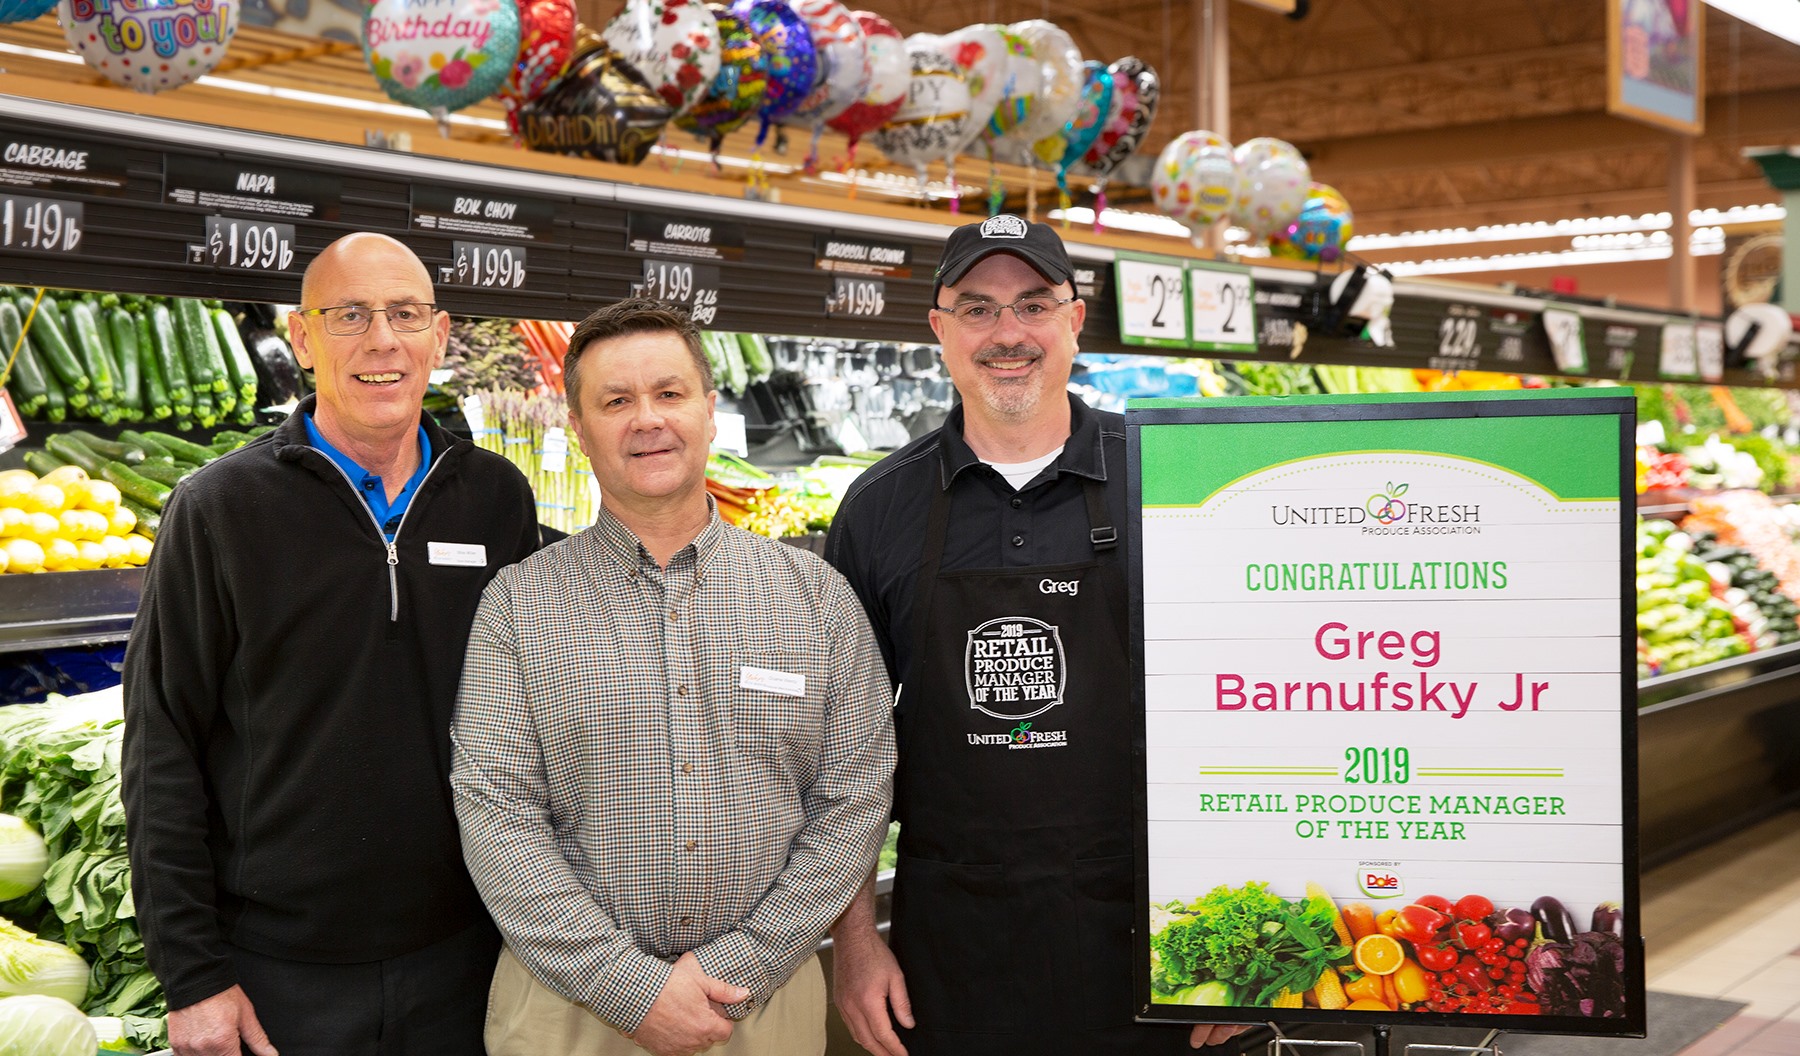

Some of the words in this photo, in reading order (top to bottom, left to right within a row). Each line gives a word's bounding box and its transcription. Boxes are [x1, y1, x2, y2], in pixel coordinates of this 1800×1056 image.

[101, 14, 145, 54] to
[366, 14, 493, 48] Birthday
[527, 114, 619, 147] BIRTHDAY
[4, 142, 88, 170] CABBAGE
[236, 172, 276, 194] NAPA
[453, 197, 482, 215] BOK
[484, 201, 517, 220] CHOY
[664, 223, 712, 243] CARROTS
[694, 289, 705, 306] 2
[691, 304, 718, 325] Bag
[1271, 505, 1367, 526] UNITED
[1406, 503, 1481, 524] FRESH
[1361, 526, 1410, 536] PRODUCE
[1412, 525, 1482, 536] ASSOCIATION
[1039, 578, 1080, 597] Greg
[1246, 561, 1508, 592] CONGRATULATIONS
[1000, 624, 1024, 638] 2019
[973, 637, 1054, 658] RETAIL
[1314, 621, 1441, 668] Greg
[974, 656, 1054, 673] PRODUCE
[974, 671, 1057, 687] MANAGER
[975, 687, 990, 703] OF
[993, 685, 1020, 702] THE
[1022, 684, 1057, 701] YEAR
[1215, 671, 1479, 720] Barnufsky
[1497, 673, 1550, 712] Jr
[967, 733, 1013, 745] UNITED
[1029, 730, 1068, 743] FRESH
[1344, 746, 1410, 784] 2019
[1199, 793, 1289, 813] RETAIL
[1295, 794, 1422, 815] PRODUCE
[1429, 795, 1566, 816] MANAGER
[1295, 819, 1330, 839] OF
[1336, 820, 1390, 840] THE
[1396, 821, 1467, 841] YEAR
[1366, 873, 1398, 888] Dole
